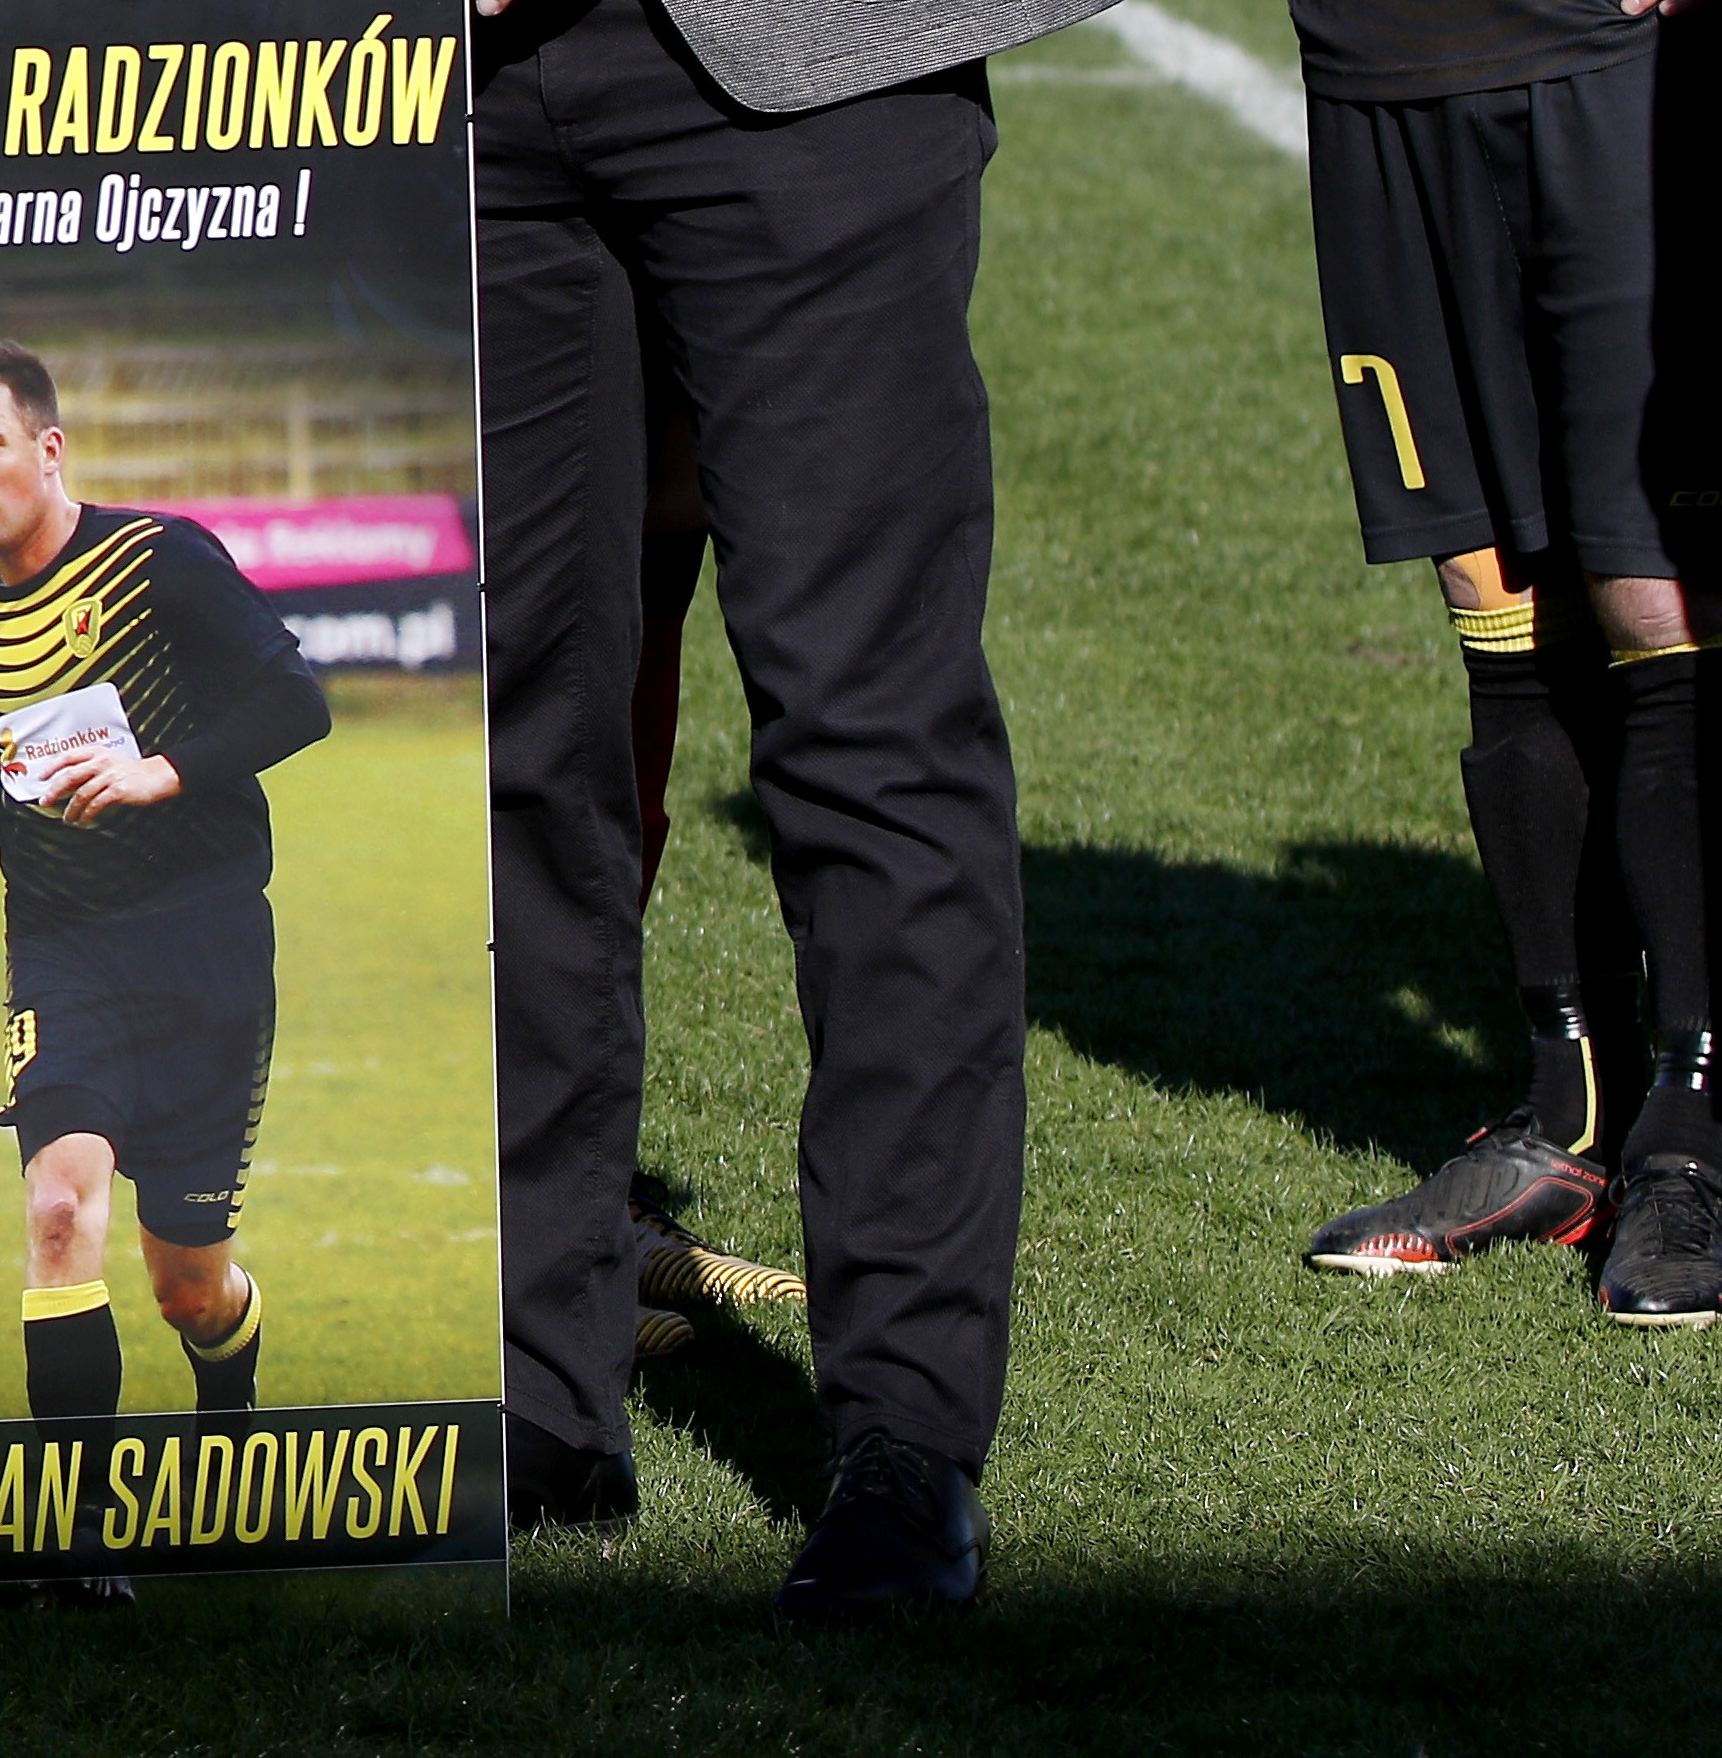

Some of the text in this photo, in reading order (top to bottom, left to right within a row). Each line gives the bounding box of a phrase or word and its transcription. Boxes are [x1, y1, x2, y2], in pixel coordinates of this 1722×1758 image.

[3, 14, 457, 157] RADZIONKÓW
[94, 172, 278, 254] Ojczyzna
[1340, 354, 1426, 490] 7
[25, 726, 110, 760] Radzionków
[101, 1424, 461, 1550] SADOWSKI
